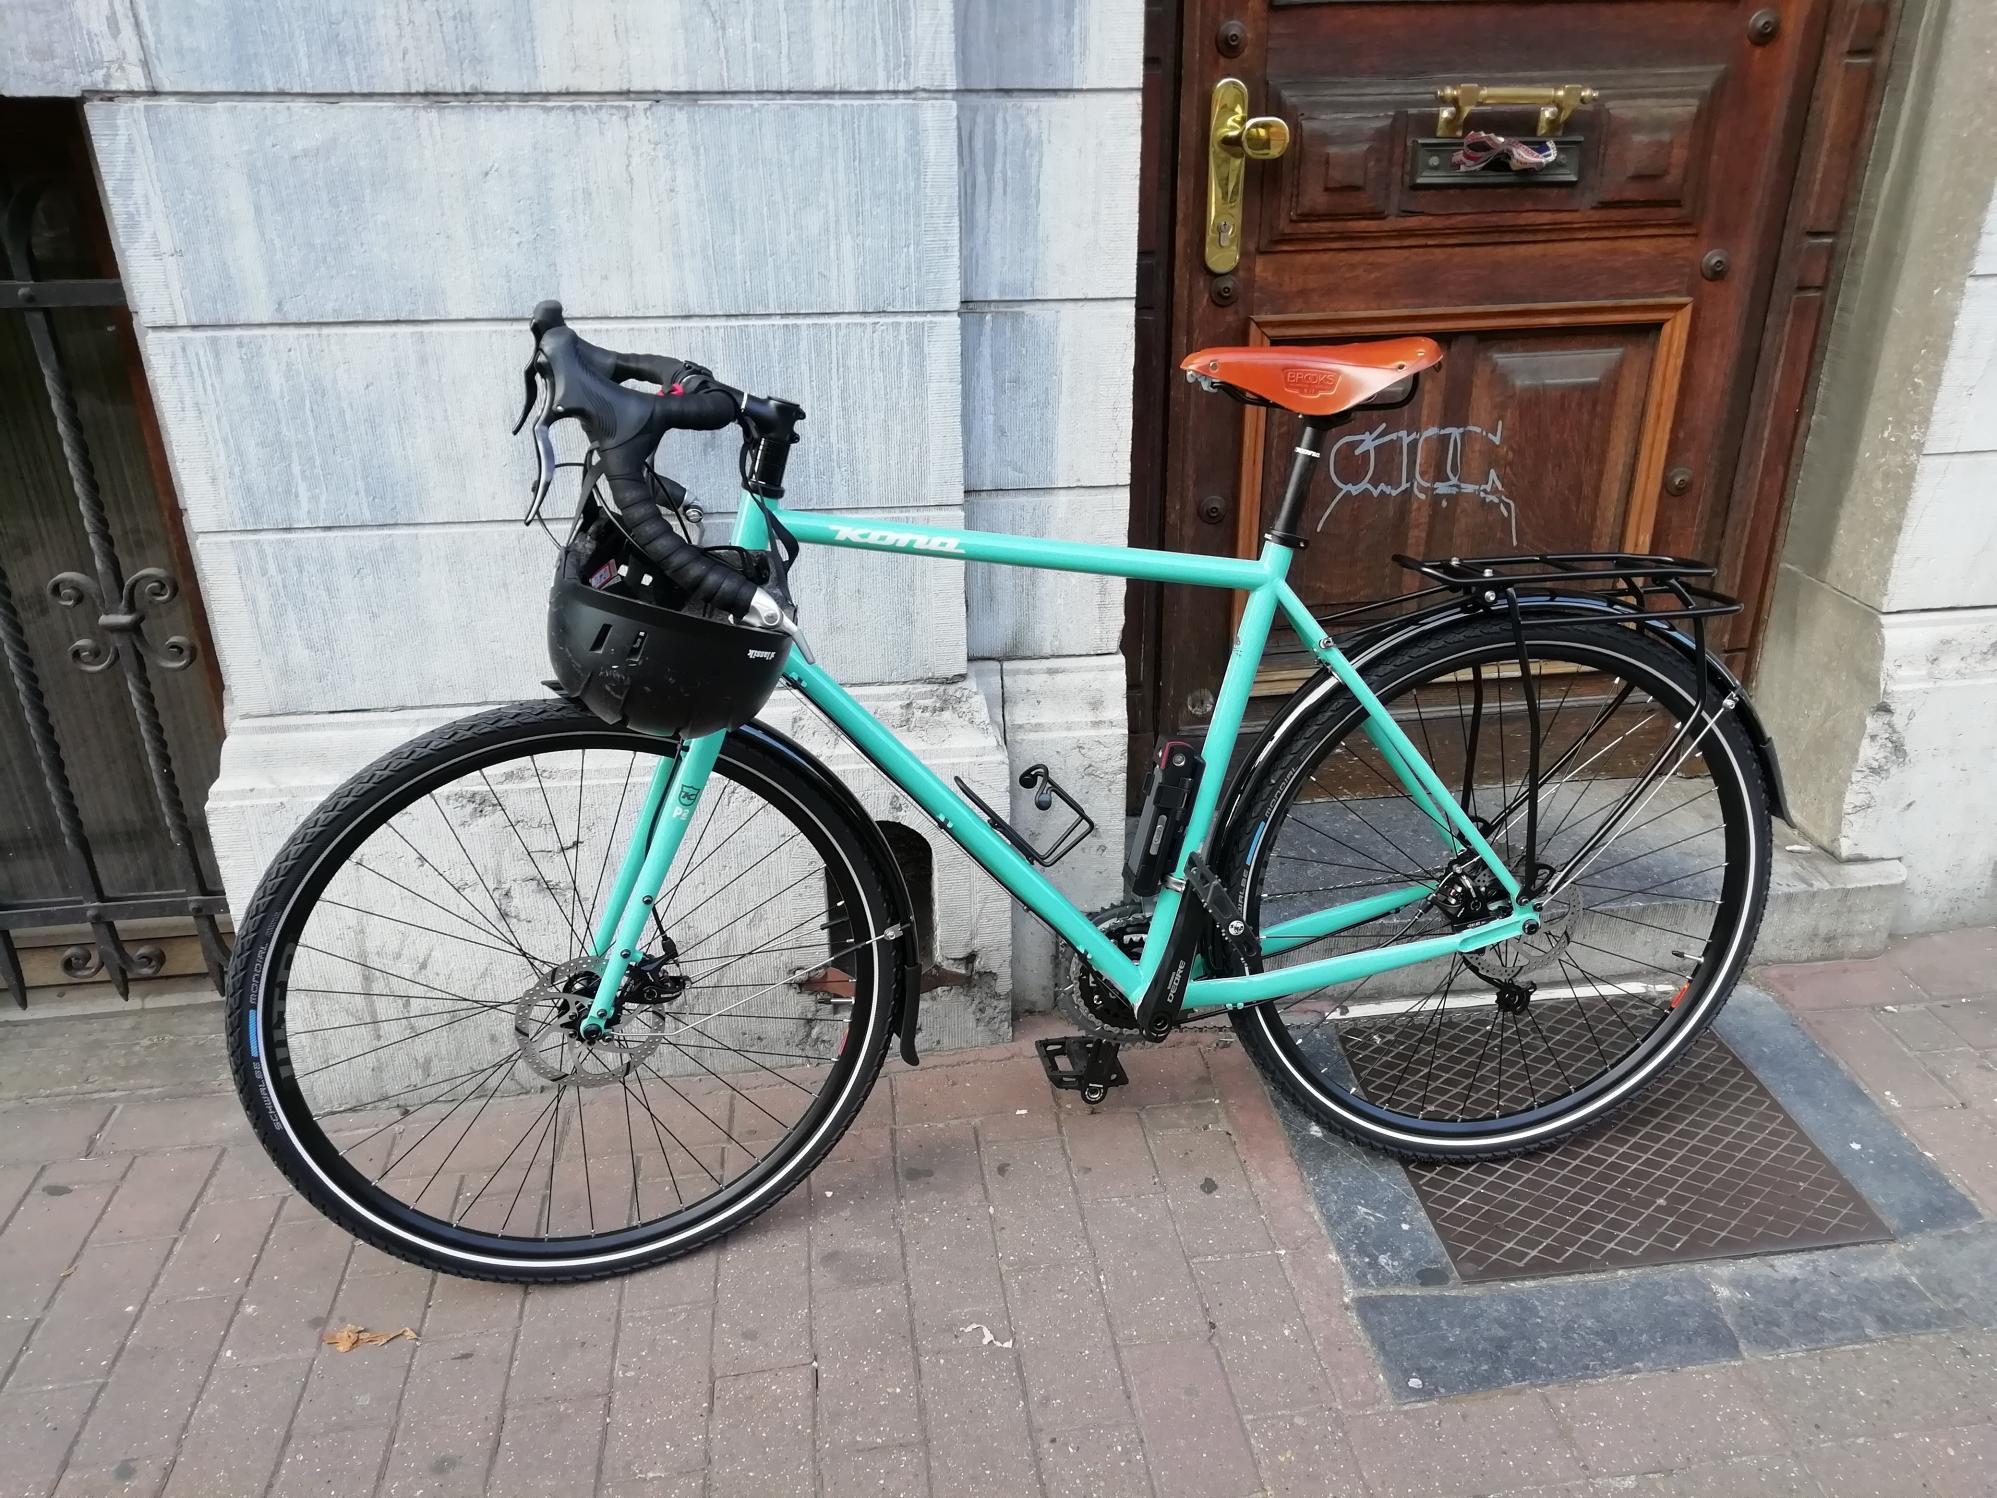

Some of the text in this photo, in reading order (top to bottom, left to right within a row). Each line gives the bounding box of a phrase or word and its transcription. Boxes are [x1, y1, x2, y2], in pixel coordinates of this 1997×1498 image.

[1287, 371, 1335, 385] BROOKS
[1264, 766, 1299, 818] MONDIAL
[249, 942, 269, 1005] MONDIAL
[1167, 959, 1186, 1003] DEORE
[252, 1061, 284, 1132] SCHWALBE
